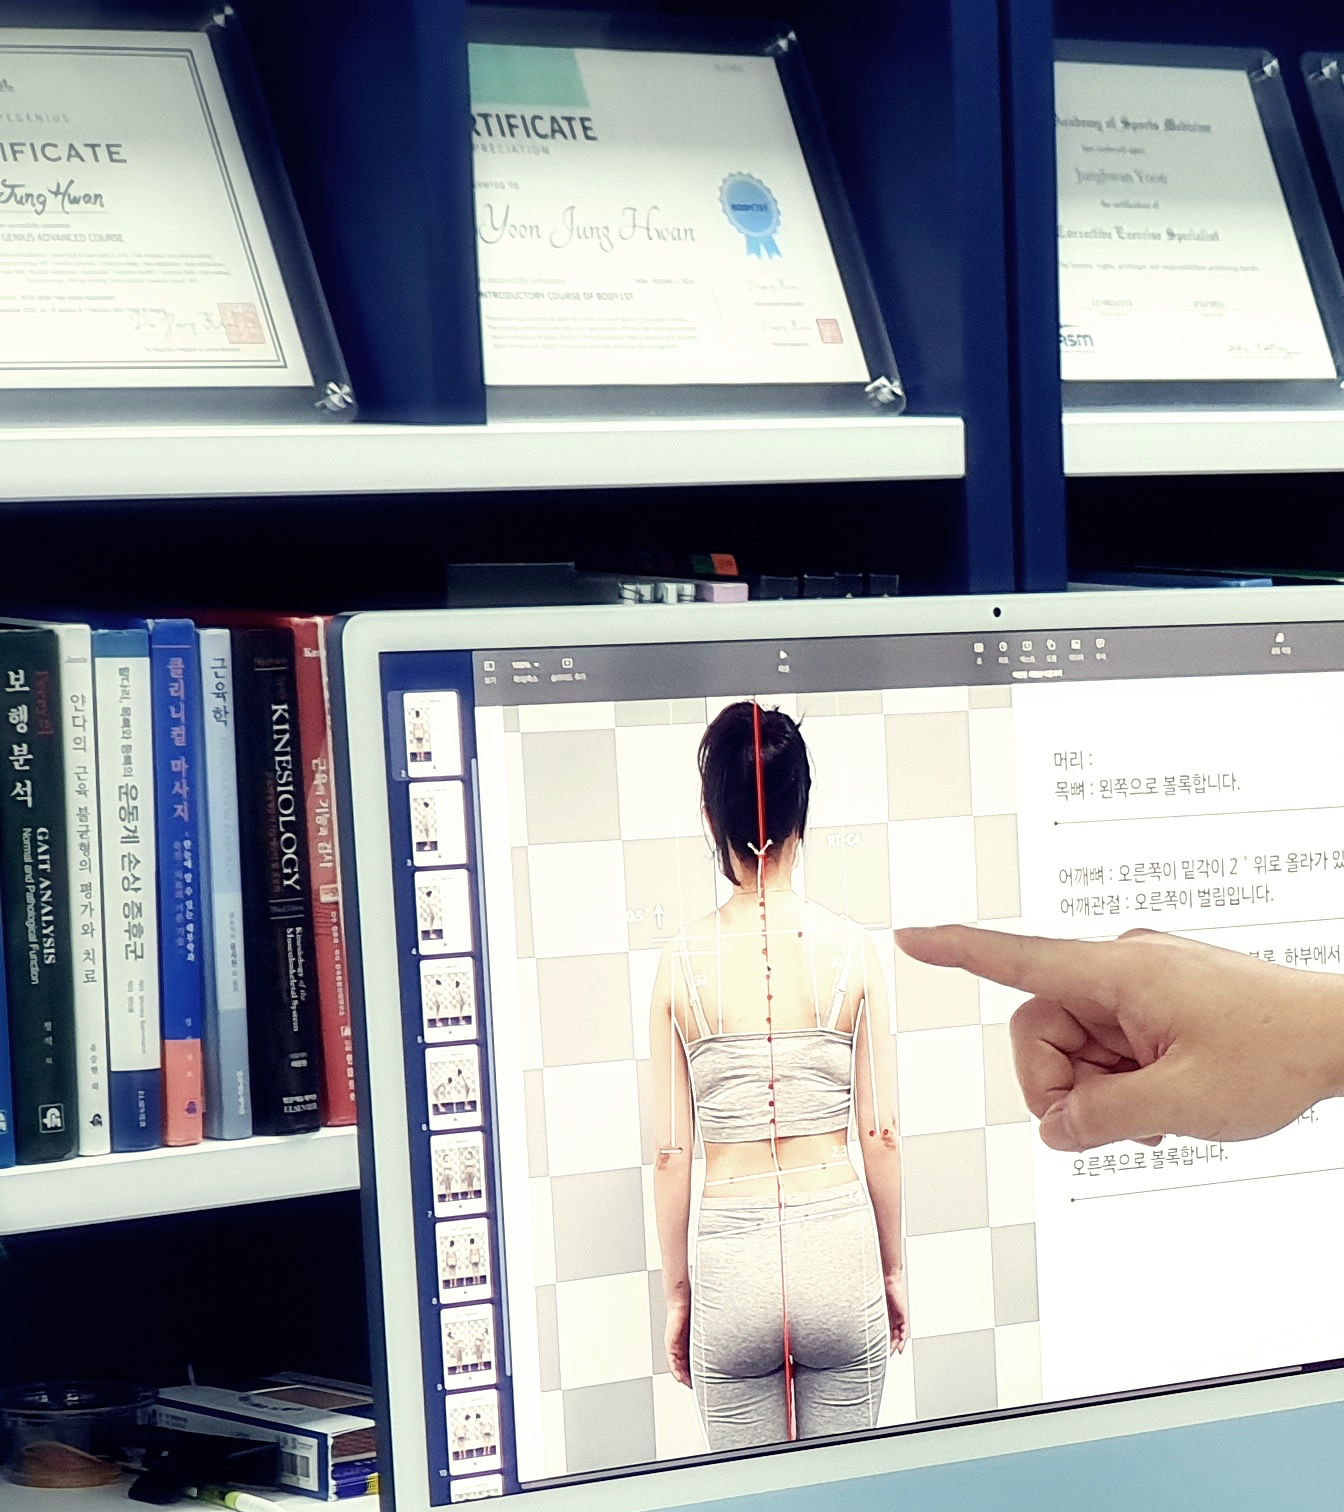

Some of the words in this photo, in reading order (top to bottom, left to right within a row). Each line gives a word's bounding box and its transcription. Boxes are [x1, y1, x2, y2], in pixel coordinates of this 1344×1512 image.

[479, 203, 542, 244] Yoon
[619, 205, 696, 242] Hwan
[1053, 750, 1084, 771] 머리
[271, 702, 300, 891] KINESIOLOGY
[1055, 780, 1085, 801] 목뼈
[1099, 776, 1159, 800] 왼쪽으로
[1162, 772, 1241, 796] 볼록합니다.
[118, 782, 140, 845] 운동계
[37, 827, 52, 872] GAIT
[1058, 865, 1104, 886] 어깨뼈
[1117, 859, 1176, 883] 오른쪽이
[1181, 858, 1225, 880] 밑각이
[1253, 854, 1282, 875] 위로
[1285, 850, 1328, 874] 올라가
[121, 852, 142, 894] 손상
[1060, 894, 1121, 917] 어깨관절
[1134, 891, 1193, 913] 오른쪽이
[1197, 883, 1274, 909] 벌림입니다.
[39, 878, 56, 965] ANALYSIS
[123, 901, 145, 962] 증후군
[1284, 944, 1341, 966] 하부에서
[1072, 1152, 1146, 1178] 오른쪽으로
[1151, 1142, 1228, 1171] 볼록합니다.
